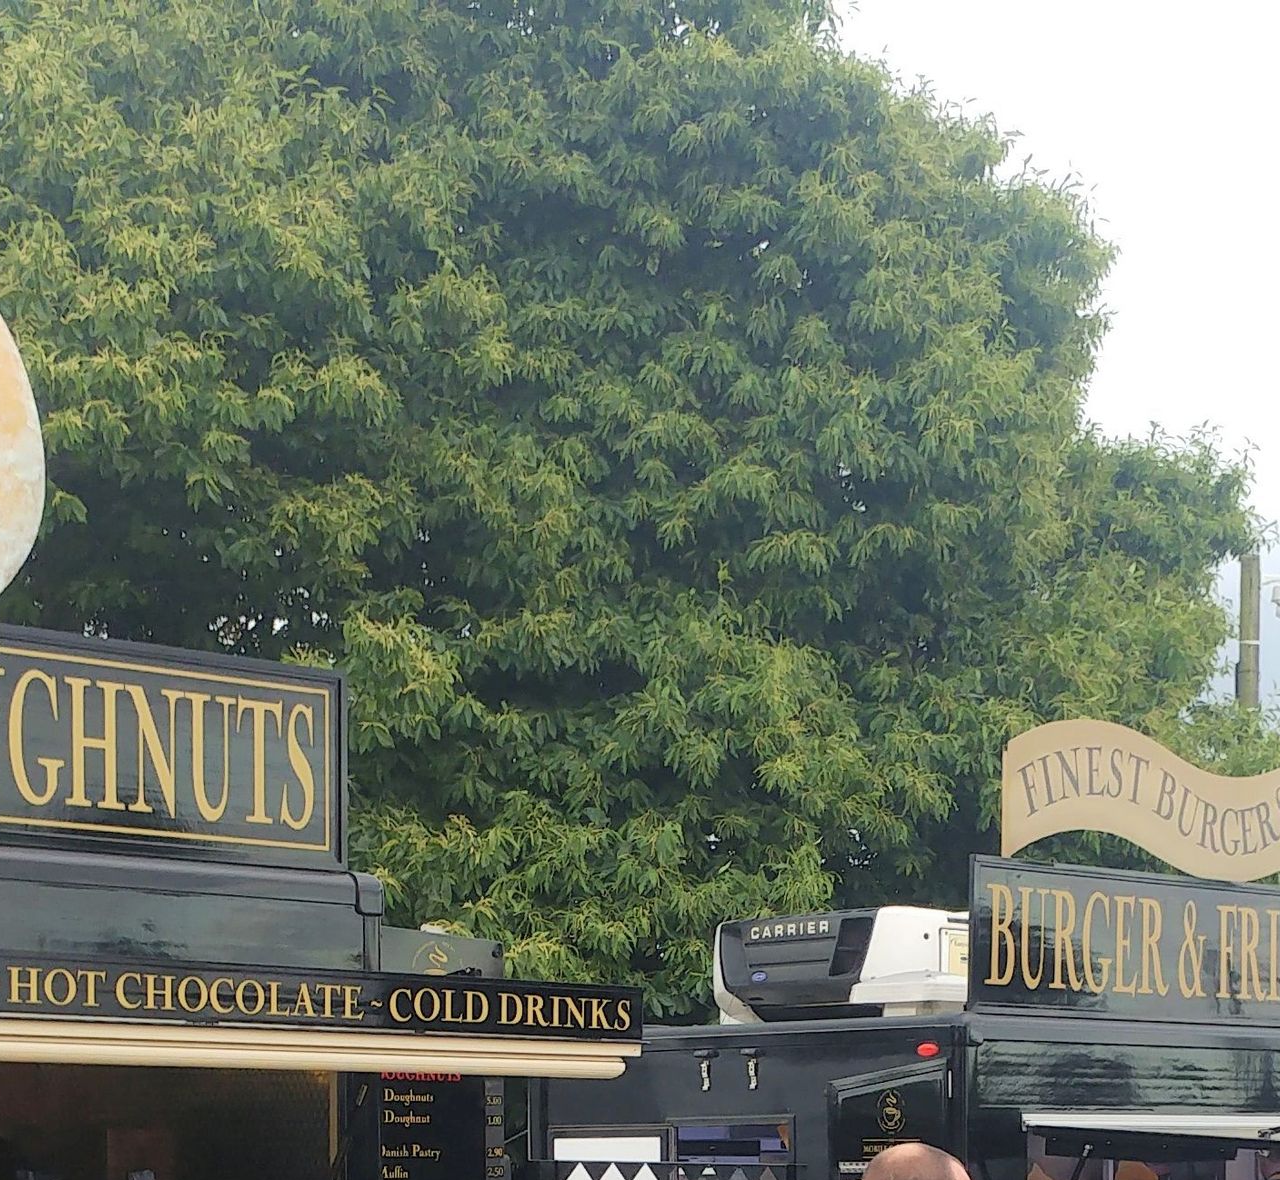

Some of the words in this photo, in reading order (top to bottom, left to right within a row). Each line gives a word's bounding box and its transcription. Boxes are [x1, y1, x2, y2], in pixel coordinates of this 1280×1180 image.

[1016, 746, 1150, 817] FINEST
[750, 920, 830, 940] CARRIER
[985, 882, 1169, 1000] BURGER
[1179, 901, 1207, 998] &
[7, 968, 106, 1011] HOT
[115, 972, 365, 1022] CHOCOLATE
[388, 988, 495, 1024] COLD
[499, 993, 632, 1032] DRINKS
[384, 1089, 434, 1106] Doughnuts
[384, 1110, 431, 1127] Doughnut
[412, 1144, 441, 1161] Pastry
